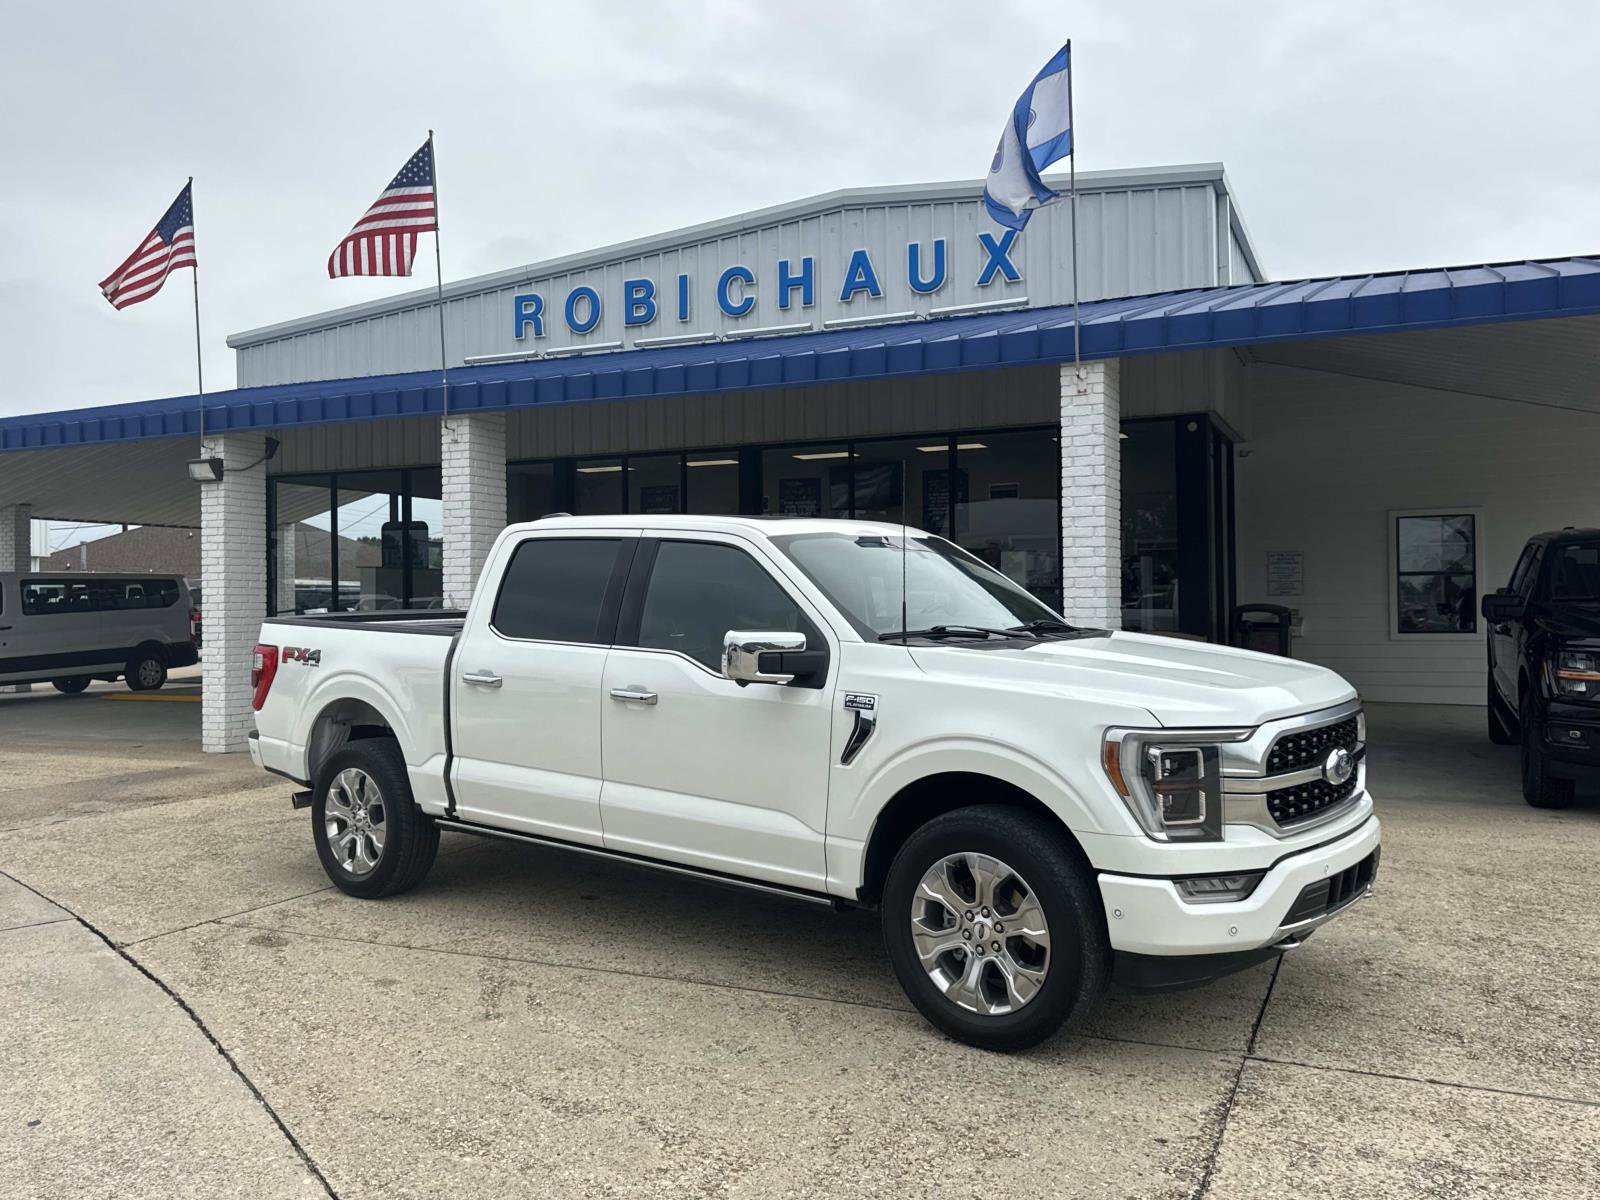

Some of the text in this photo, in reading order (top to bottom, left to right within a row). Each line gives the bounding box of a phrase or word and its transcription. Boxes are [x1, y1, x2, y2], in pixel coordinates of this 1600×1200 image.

[513, 228, 1023, 340] ROBICHAUX
[282, 646, 321, 663] FX4
[846, 695, 874, 704] F-150
